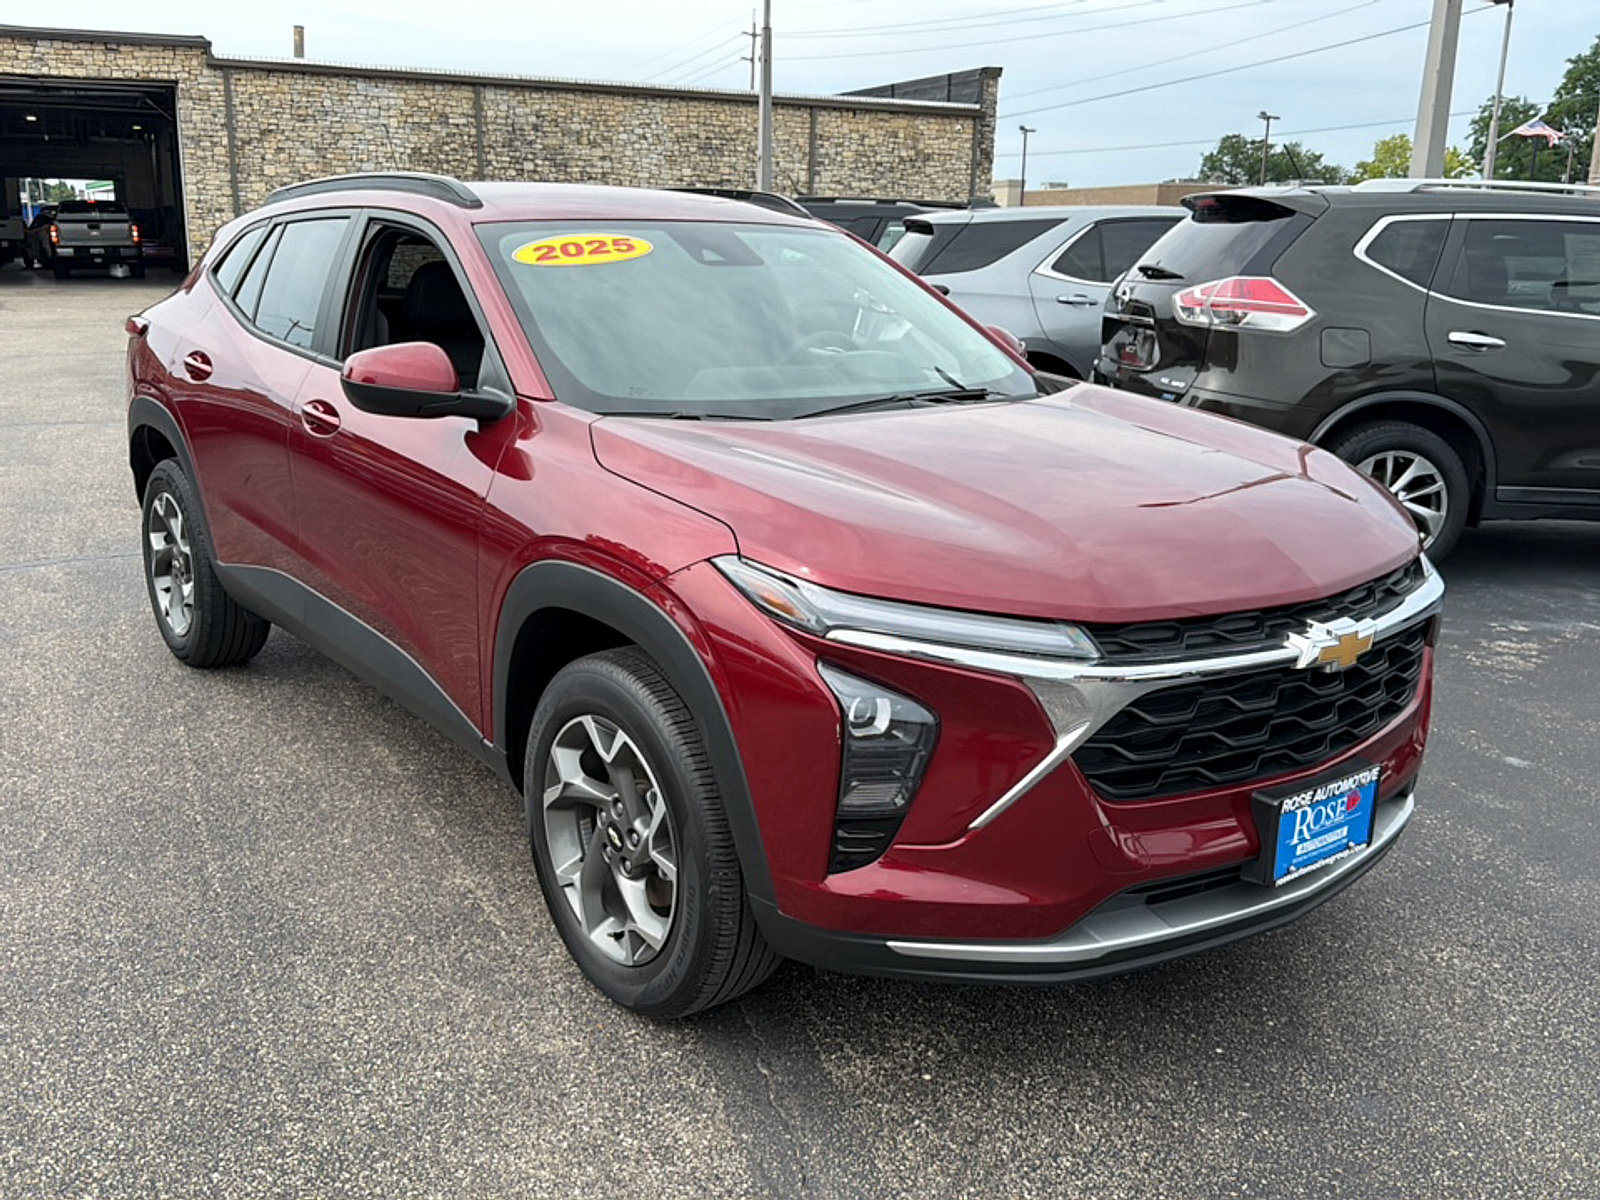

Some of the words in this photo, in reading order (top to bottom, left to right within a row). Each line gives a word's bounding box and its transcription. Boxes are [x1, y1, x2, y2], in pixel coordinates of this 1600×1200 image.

[533, 238, 636, 262] 2025
[1281, 791, 1315, 814] ROSE
[1313, 766, 1381, 803] AUTOMOTIVE
